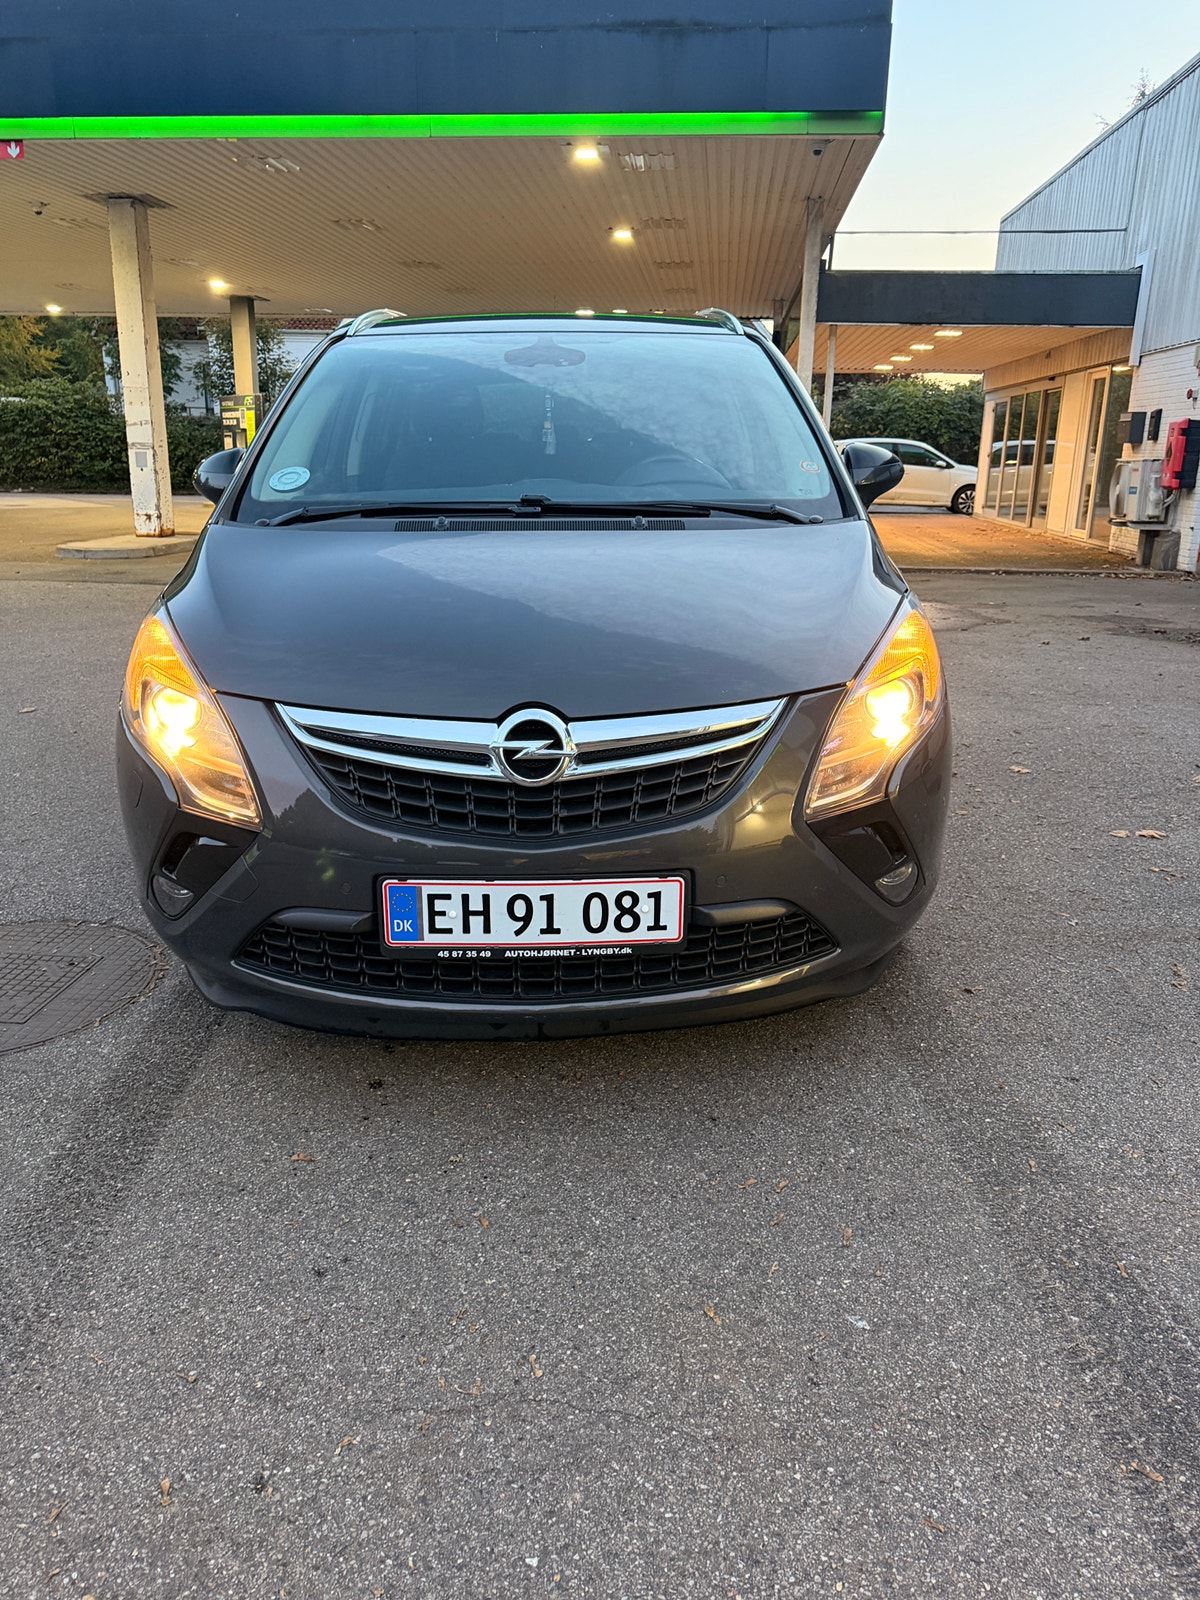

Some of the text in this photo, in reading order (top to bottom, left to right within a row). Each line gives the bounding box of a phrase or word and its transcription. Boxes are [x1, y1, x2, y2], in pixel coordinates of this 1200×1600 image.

[426, 890, 668, 937] EH 91 081
[393, 919, 413, 933] DK
[437, 950, 492, 958] 45 87 35 49
[504, 948, 577, 957] AUTOHJØRNET
[581, 947, 633, 956] LYNGBY.dk
